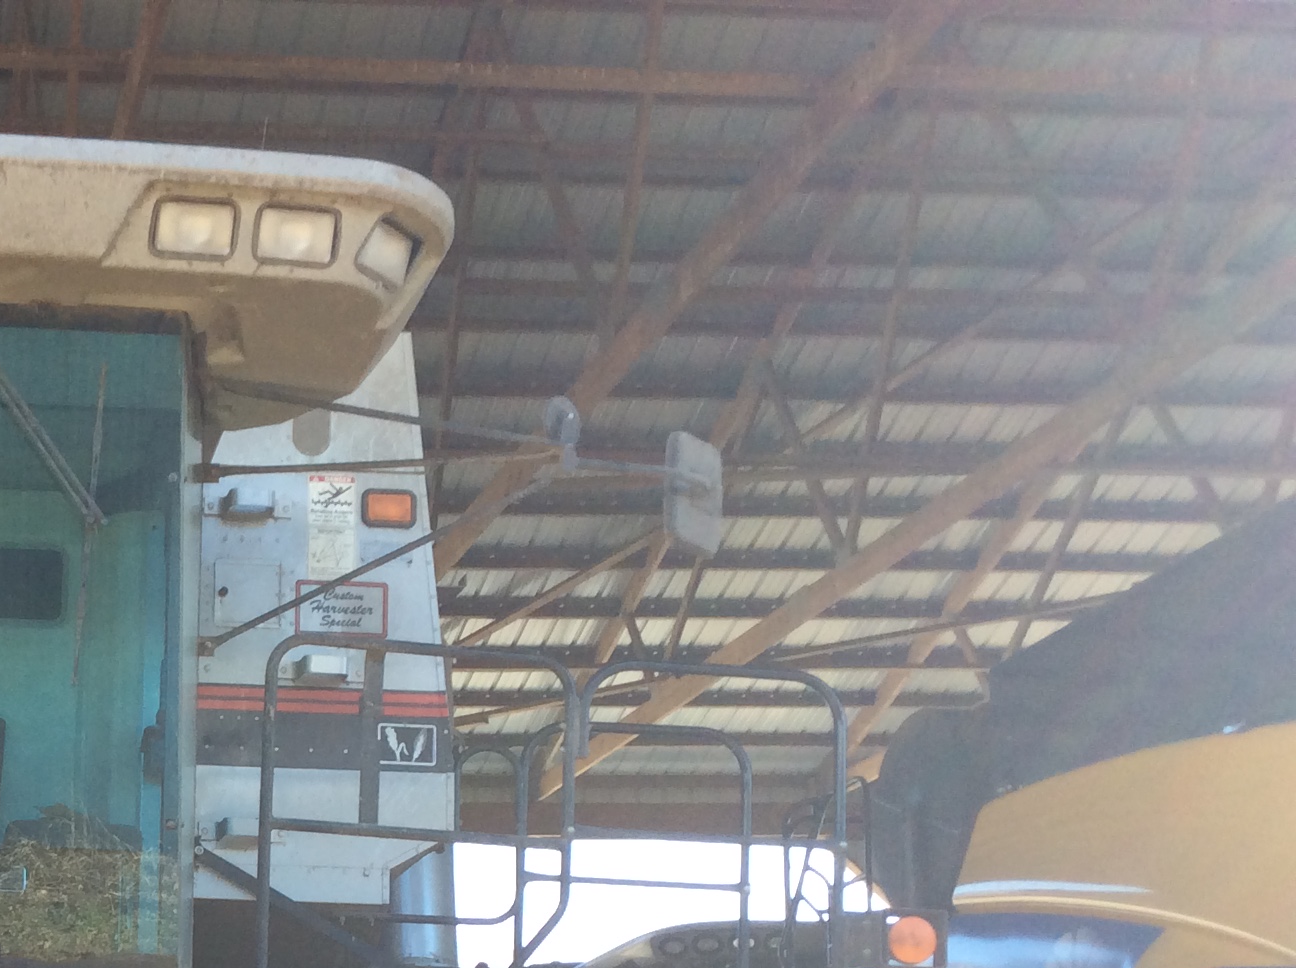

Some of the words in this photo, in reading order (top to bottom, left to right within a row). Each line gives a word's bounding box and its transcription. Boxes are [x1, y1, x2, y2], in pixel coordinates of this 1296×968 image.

[323, 588, 364, 601] Custom
[310, 600, 373, 615] Harvester
[320, 615, 363, 628] Special
